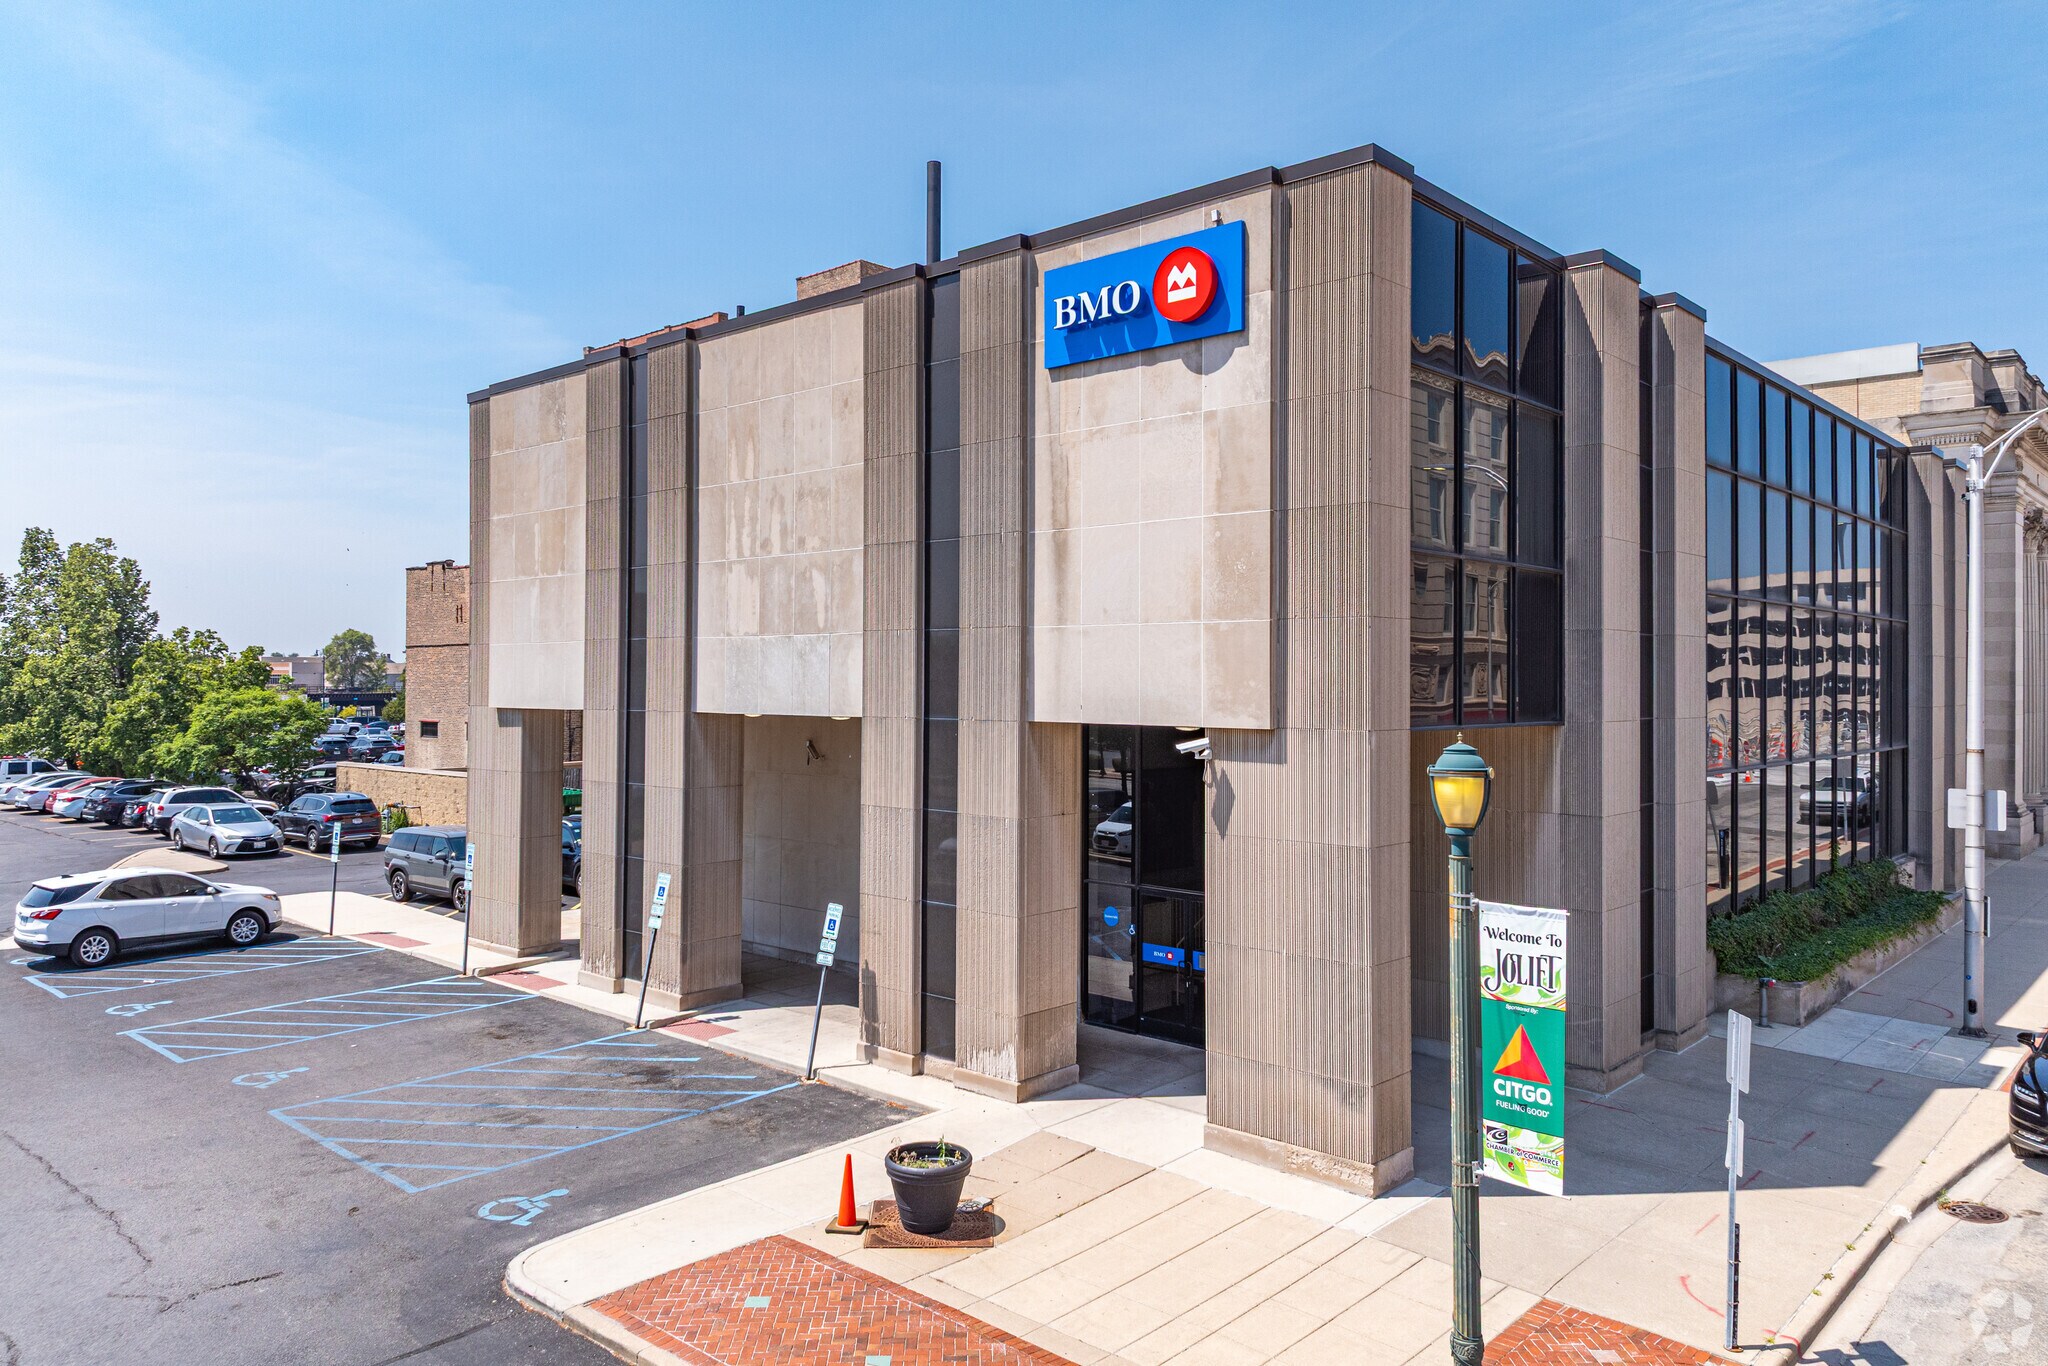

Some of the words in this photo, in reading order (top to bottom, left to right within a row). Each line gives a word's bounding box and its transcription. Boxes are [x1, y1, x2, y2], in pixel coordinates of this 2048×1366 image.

[1053, 280, 1141, 330] BMO
[1483, 925, 1542, 946] Welcome
[1546, 934, 1562, 947] To
[1484, 948, 1562, 993] JOLIET
[1493, 1078, 1552, 1106] CITGO
[1496, 1100, 1526, 1112] FUELING
[1486, 1142, 1515, 1155] CHAMBER
[1524, 1152, 1559, 1167] COMMERCE
